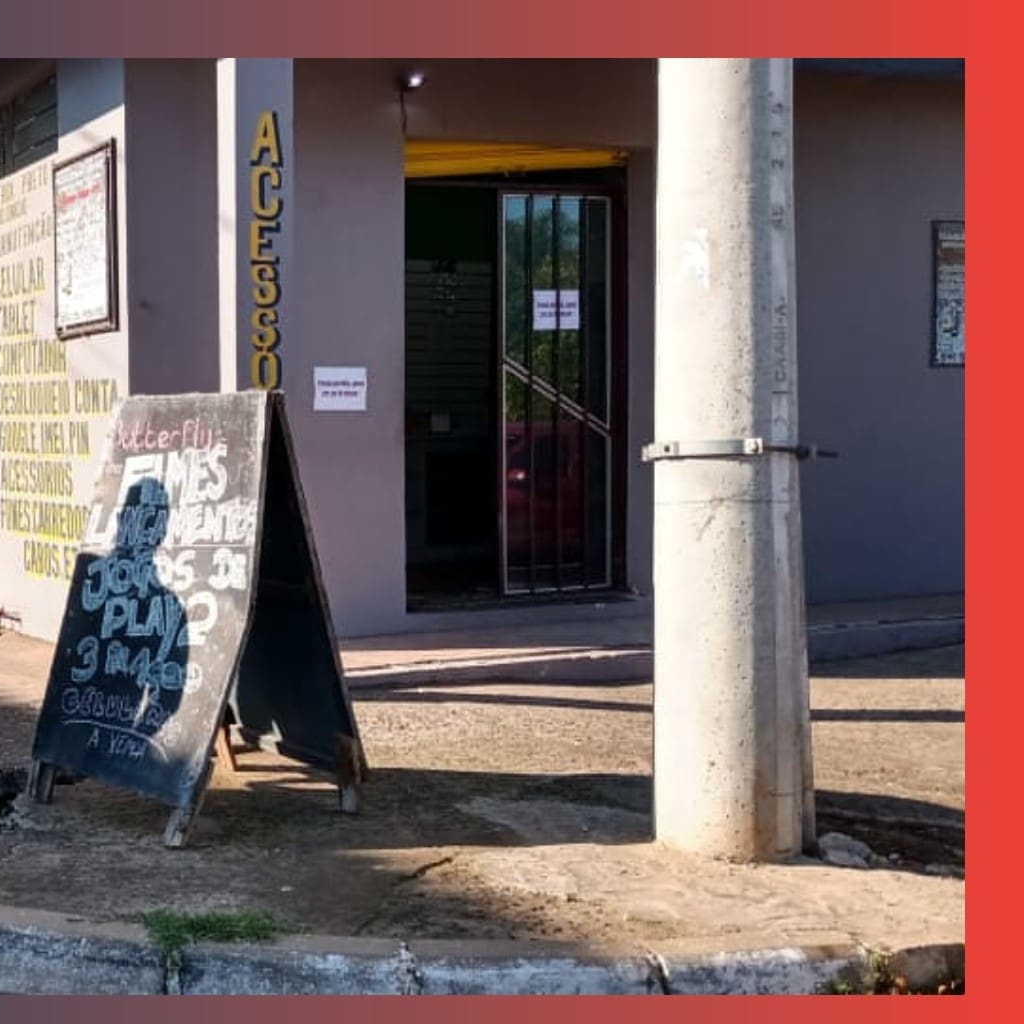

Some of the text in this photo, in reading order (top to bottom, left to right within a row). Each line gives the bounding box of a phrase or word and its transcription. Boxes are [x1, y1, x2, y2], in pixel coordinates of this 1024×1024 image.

[250, 110, 284, 390] ACESSO
[75, 377, 120, 414] CONTA
[101, 590, 219, 663] PLAY 2
[70, 636, 99, 683] 3
